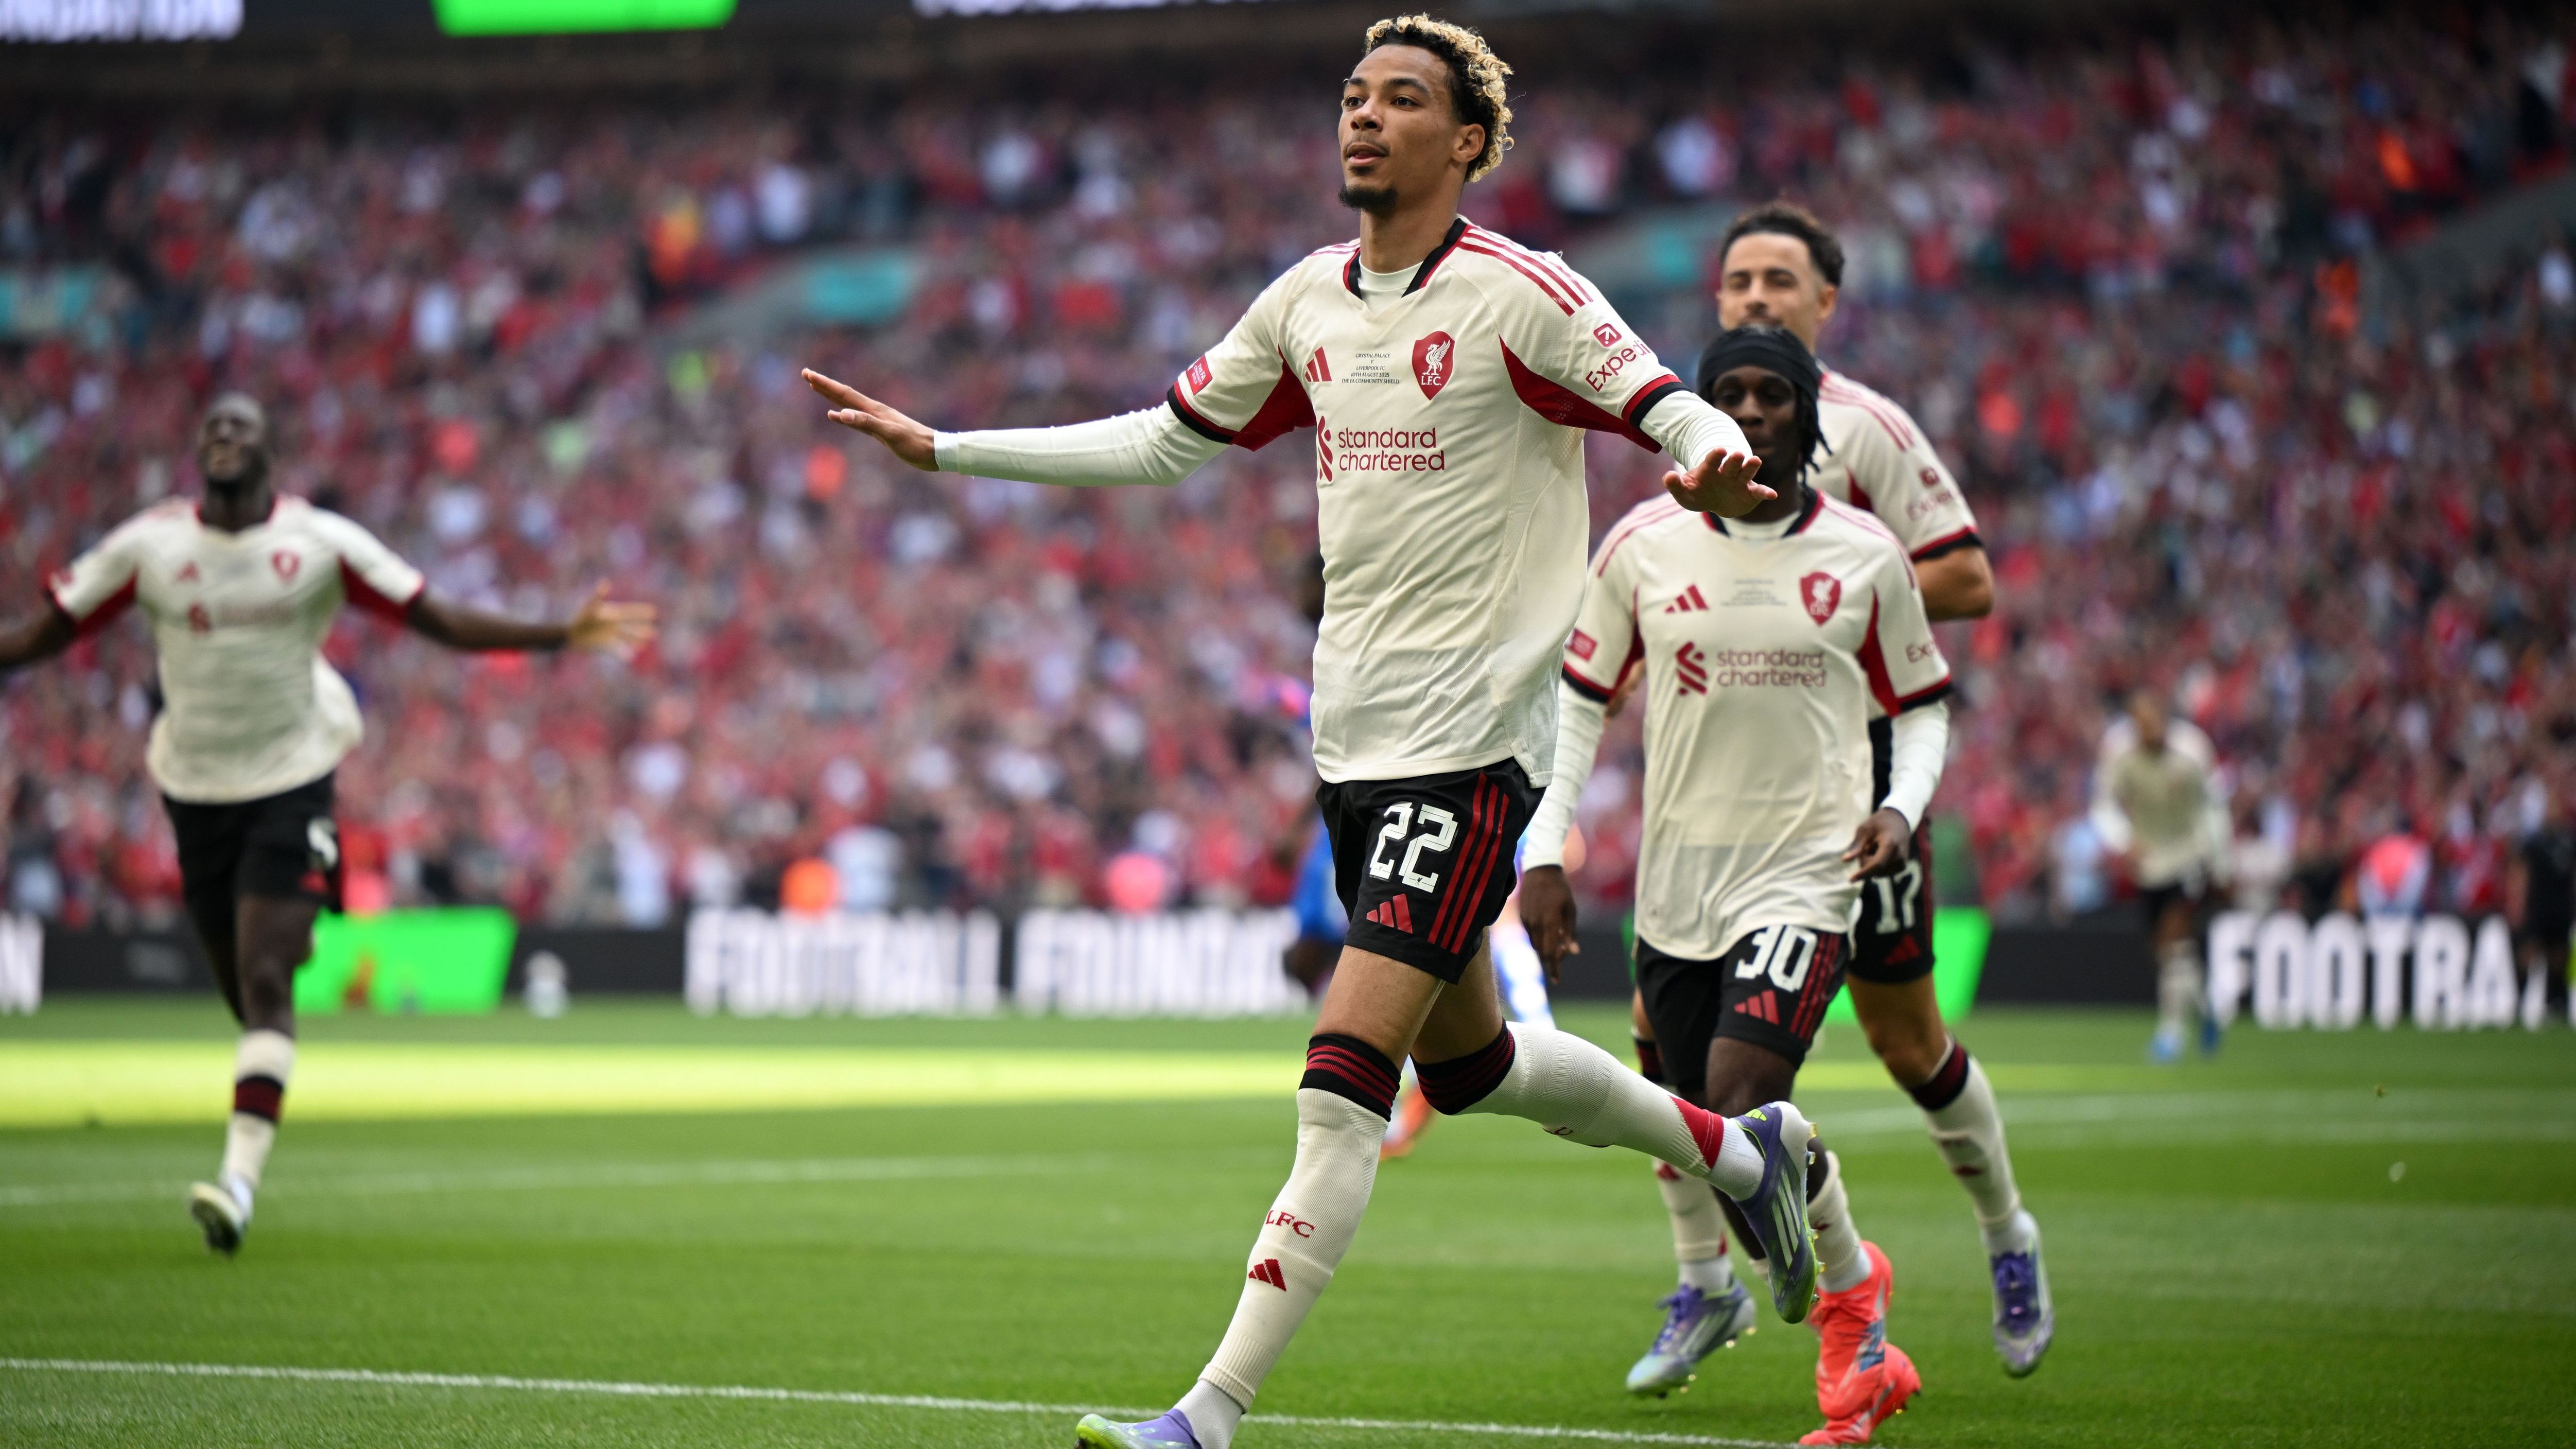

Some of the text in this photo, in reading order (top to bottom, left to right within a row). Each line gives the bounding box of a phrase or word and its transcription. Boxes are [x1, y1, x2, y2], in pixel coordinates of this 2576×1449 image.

[1338, 427, 1436, 448] standard
[1339, 450, 1445, 471] chartered
[1717, 648, 1825, 668] standard
[1717, 668, 1826, 687] chartered
[1369, 802, 1458, 893] 22
[1871, 859, 1923, 935] 17
[1735, 925, 1818, 992] 30
[1265, 1210, 1316, 1238] LFC
